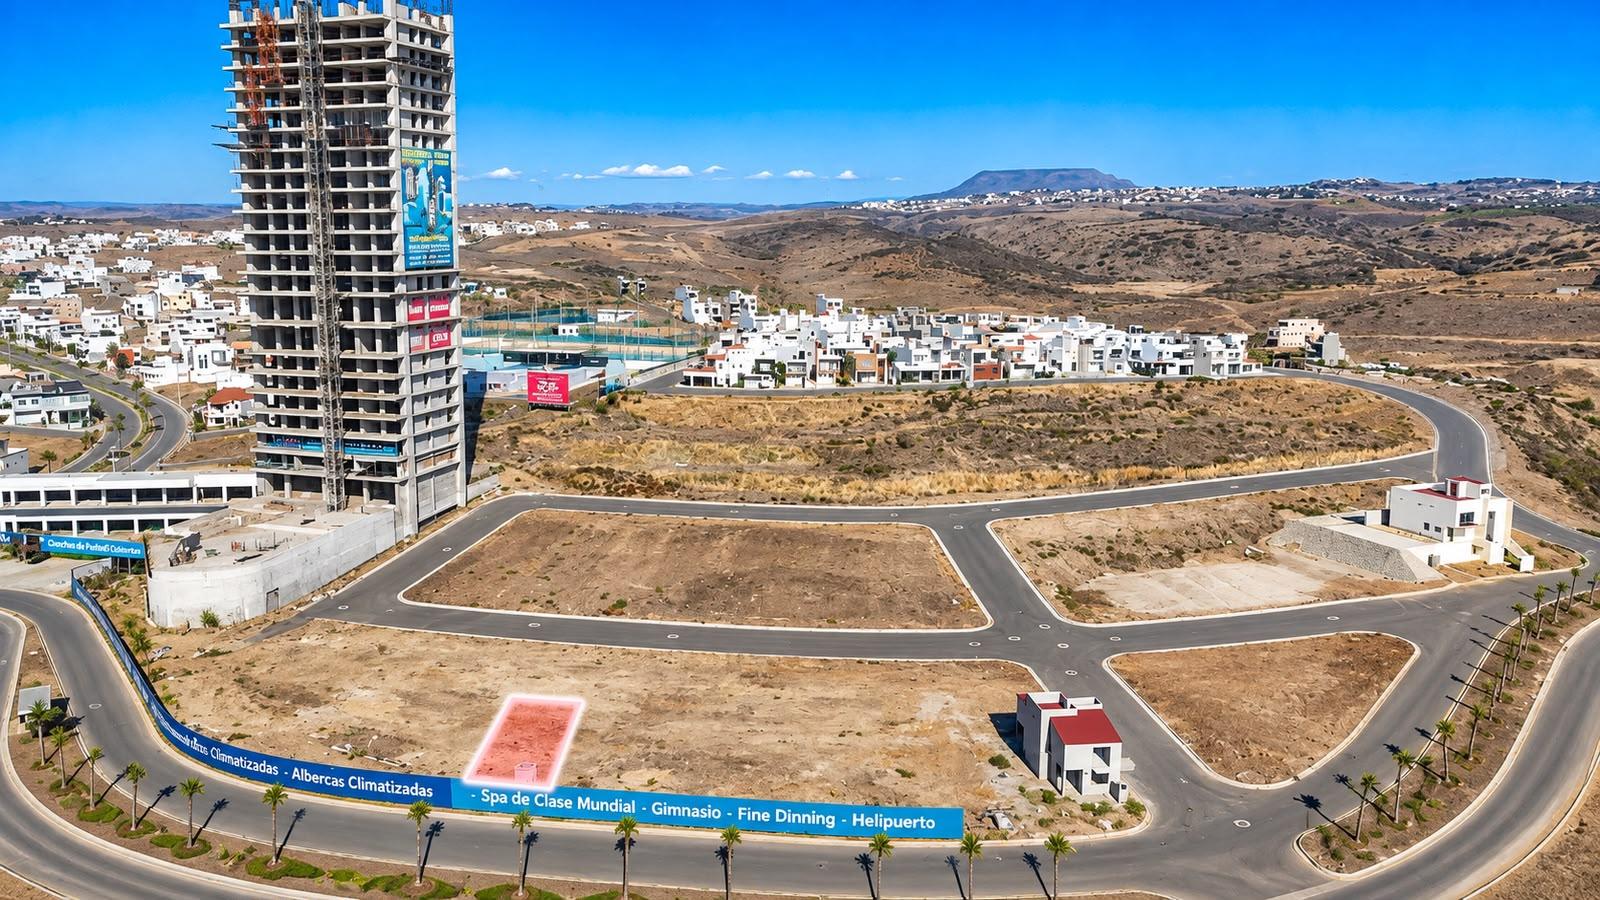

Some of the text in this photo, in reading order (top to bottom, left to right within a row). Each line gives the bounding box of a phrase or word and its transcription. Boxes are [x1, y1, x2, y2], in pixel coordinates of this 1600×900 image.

[291, 768, 346, 788] Albercas
[348, 776, 433, 798] Climatizadas
[480, 788, 508, 806] Spa
[511, 790, 530, 806] de
[534, 793, 573, 809] Clase
[577, 796, 636, 814] Mundial
[651, 801, 722, 819] Gimnasio
[737, 806, 771, 822] Fine
[775, 808, 836, 829] Dinning
[852, 813, 936, 833] Helipuerto
